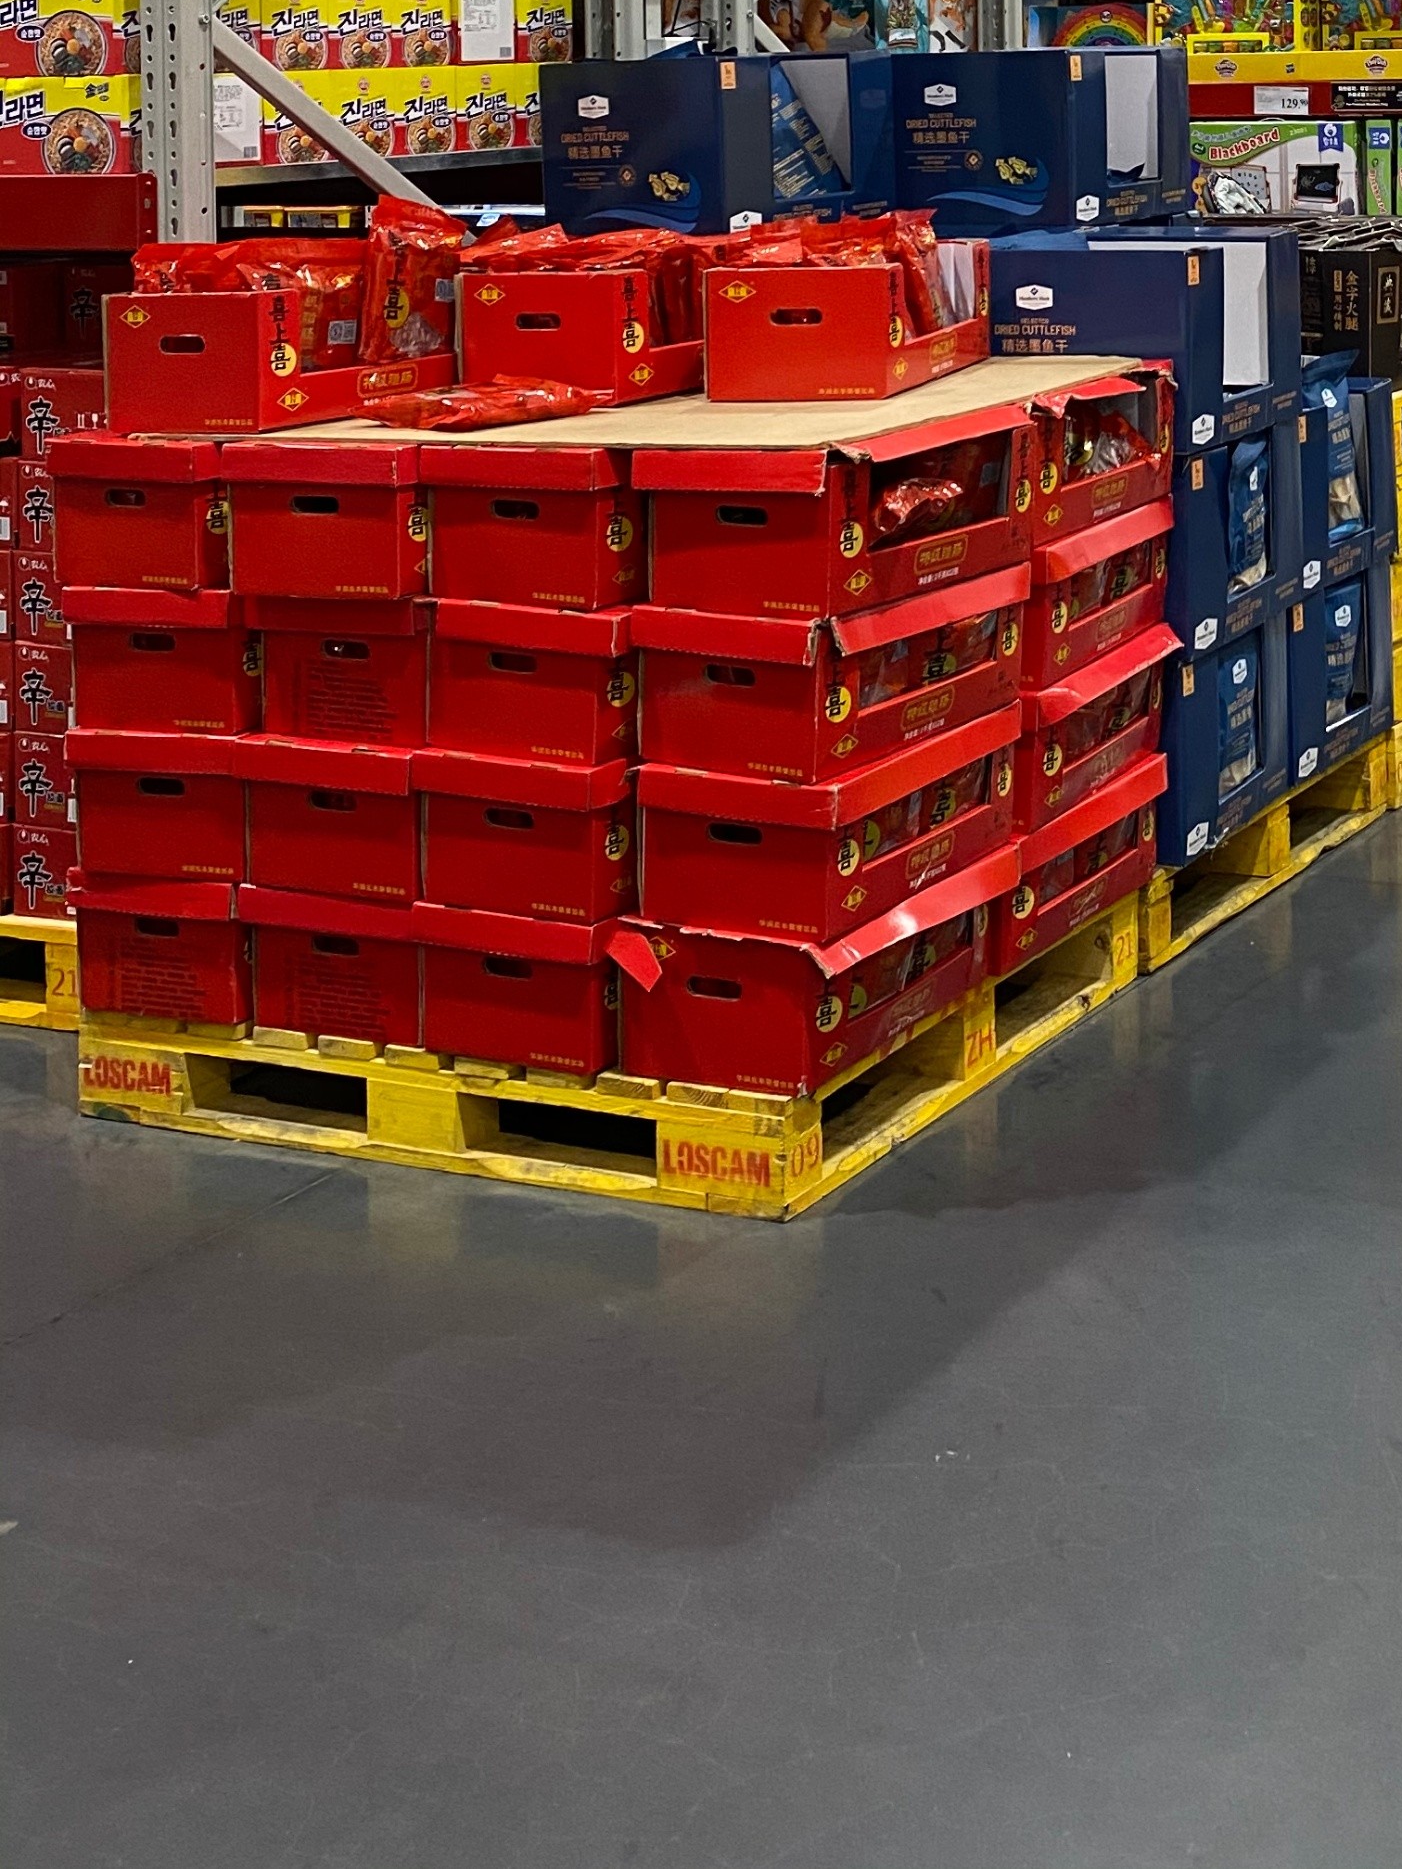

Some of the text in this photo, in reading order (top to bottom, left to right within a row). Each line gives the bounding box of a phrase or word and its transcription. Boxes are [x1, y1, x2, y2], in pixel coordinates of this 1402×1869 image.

[213, 8, 248, 30] 라면
[271, 9, 319, 36] 진라면
[338, 9, 383, 36] 진라면
[400, 8, 443, 35] 진라면
[526, 8, 565, 32] 진라면
[0, 91, 44, 124] 라면
[341, 98, 387, 126] 진라면
[404, 97, 448, 124] 진라면
[465, 93, 509, 119] 진라면
[906, 118, 977, 129] DRIED CUTTLEFISH
[1208, 127, 1280, 161] Blackboard
[623, 275, 640, 348] 喜上喜
[1345, 270, 1359, 331] 金字火腿
[268, 294, 292, 372] 喜上喜
[995, 325, 1076, 336] DRIED CUTTLEFISH
[1002, 339, 1069, 353] 精选墨鱼干
[26, 395, 60, 455] 辛
[22, 485, 54, 544] 辛
[20, 577, 53, 636] 辛
[20, 667, 53, 726] 辛
[19, 759, 53, 818] 辛
[17, 850, 53, 910] 辛
[83, 1054, 172, 1097] LOSCAM
[662, 1138, 771, 1188] LOSCAM
